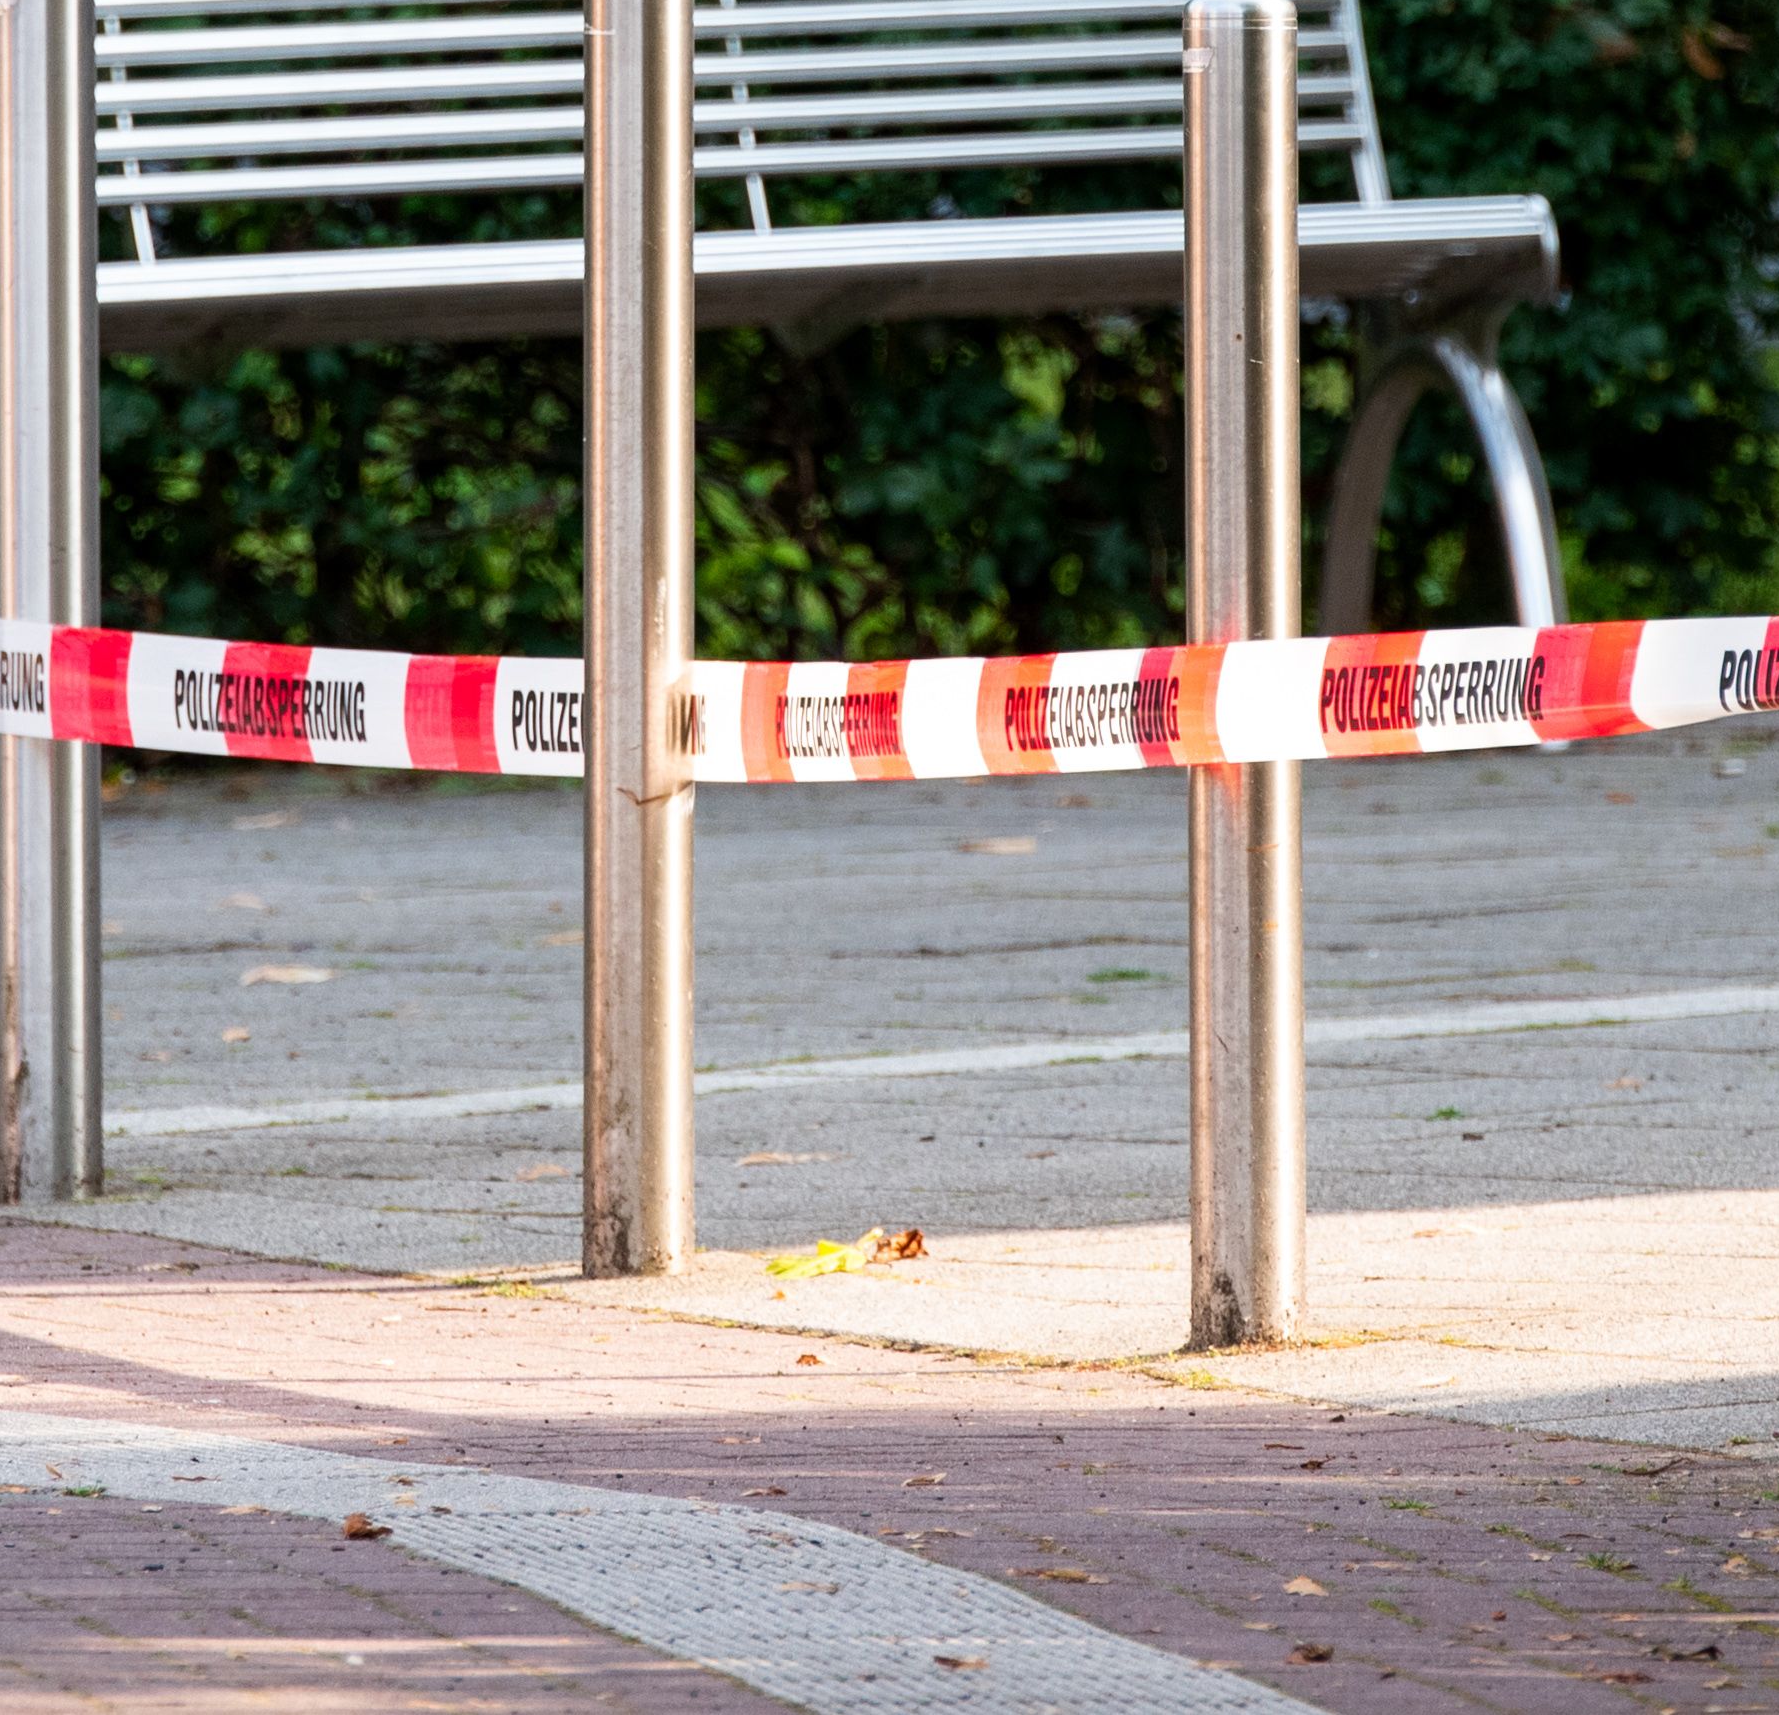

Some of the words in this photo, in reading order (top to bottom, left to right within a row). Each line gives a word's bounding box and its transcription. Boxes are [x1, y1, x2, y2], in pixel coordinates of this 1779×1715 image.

[174, 668, 368, 743] POLIZEIABSPERRUNG
[776, 691, 900, 759] POLIZEIABSPERRUNG
[1005, 676, 1180, 751] POLIZEIABSPERRUNG
[1321, 656, 1546, 734] POLIZEIABSPERRUNG
